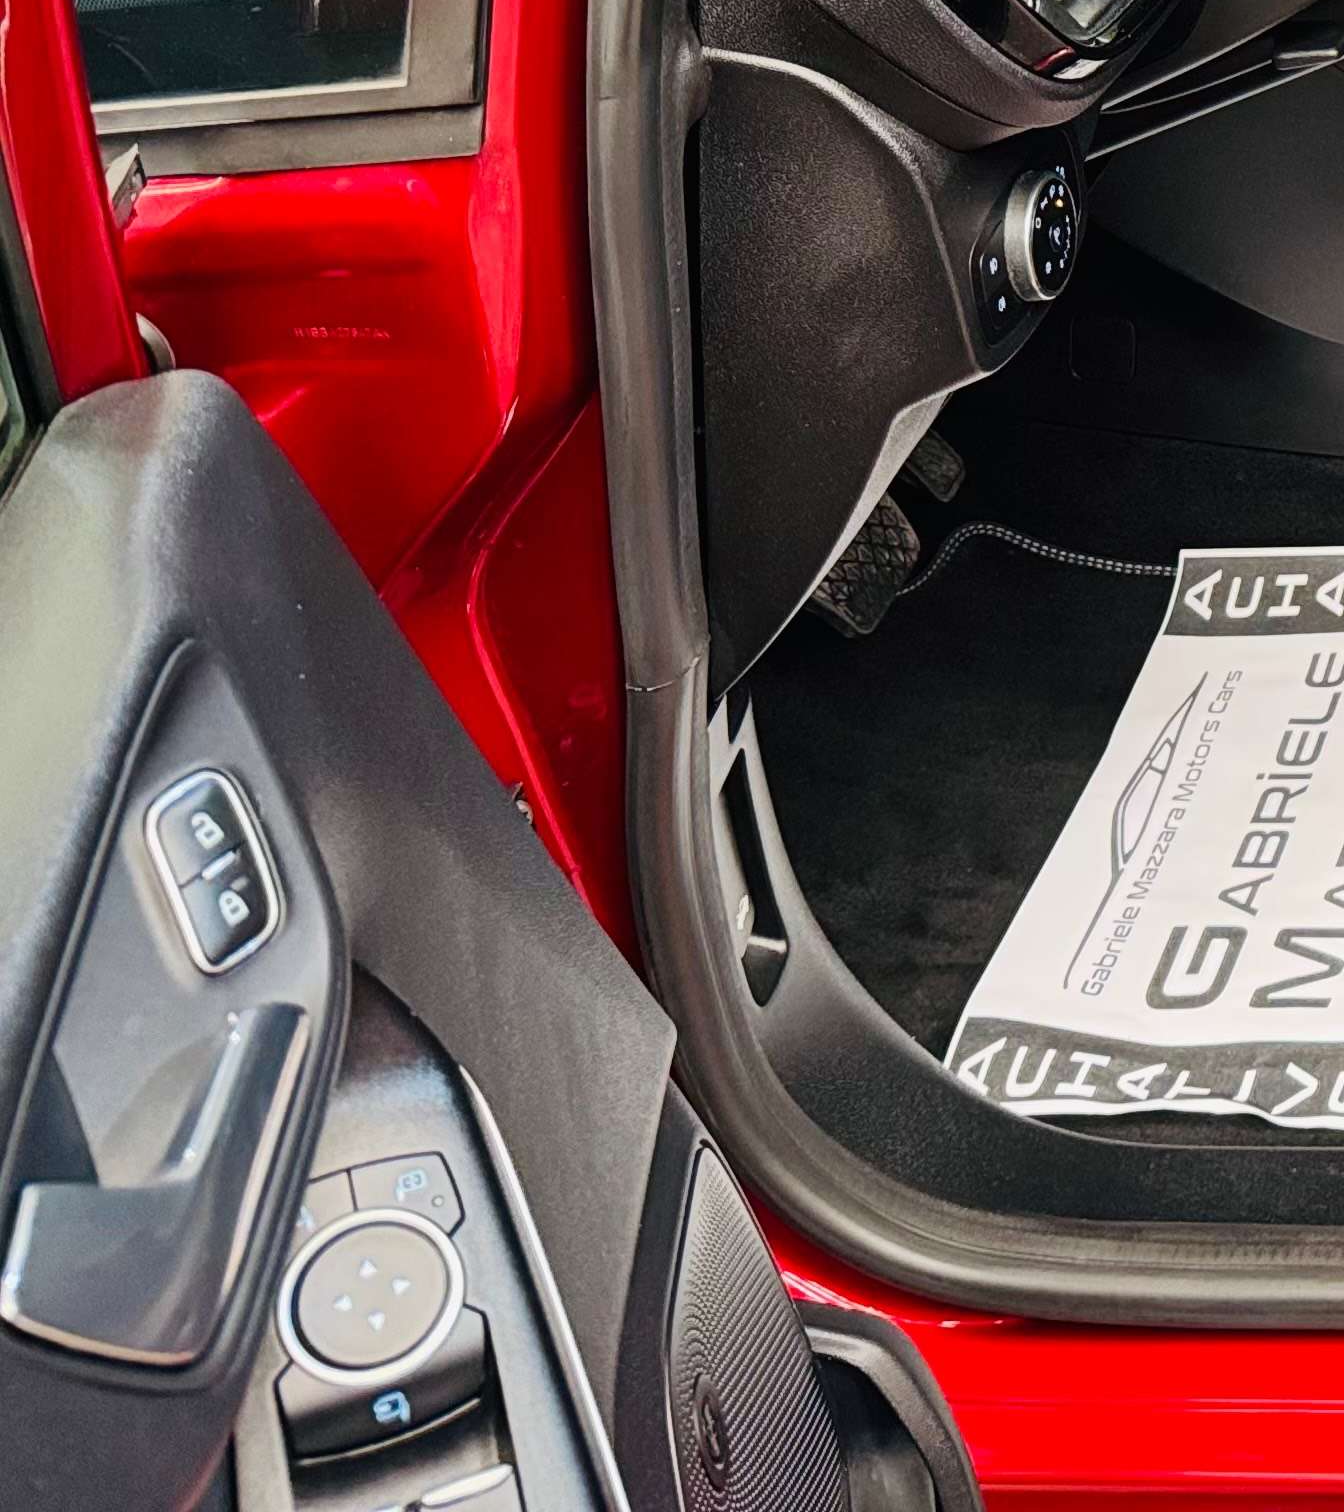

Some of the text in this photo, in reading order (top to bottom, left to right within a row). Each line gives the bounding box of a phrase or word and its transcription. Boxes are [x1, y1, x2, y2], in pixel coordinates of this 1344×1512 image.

[1081, 670, 1243, 996] Gabriele Mazzara Motors Cars
